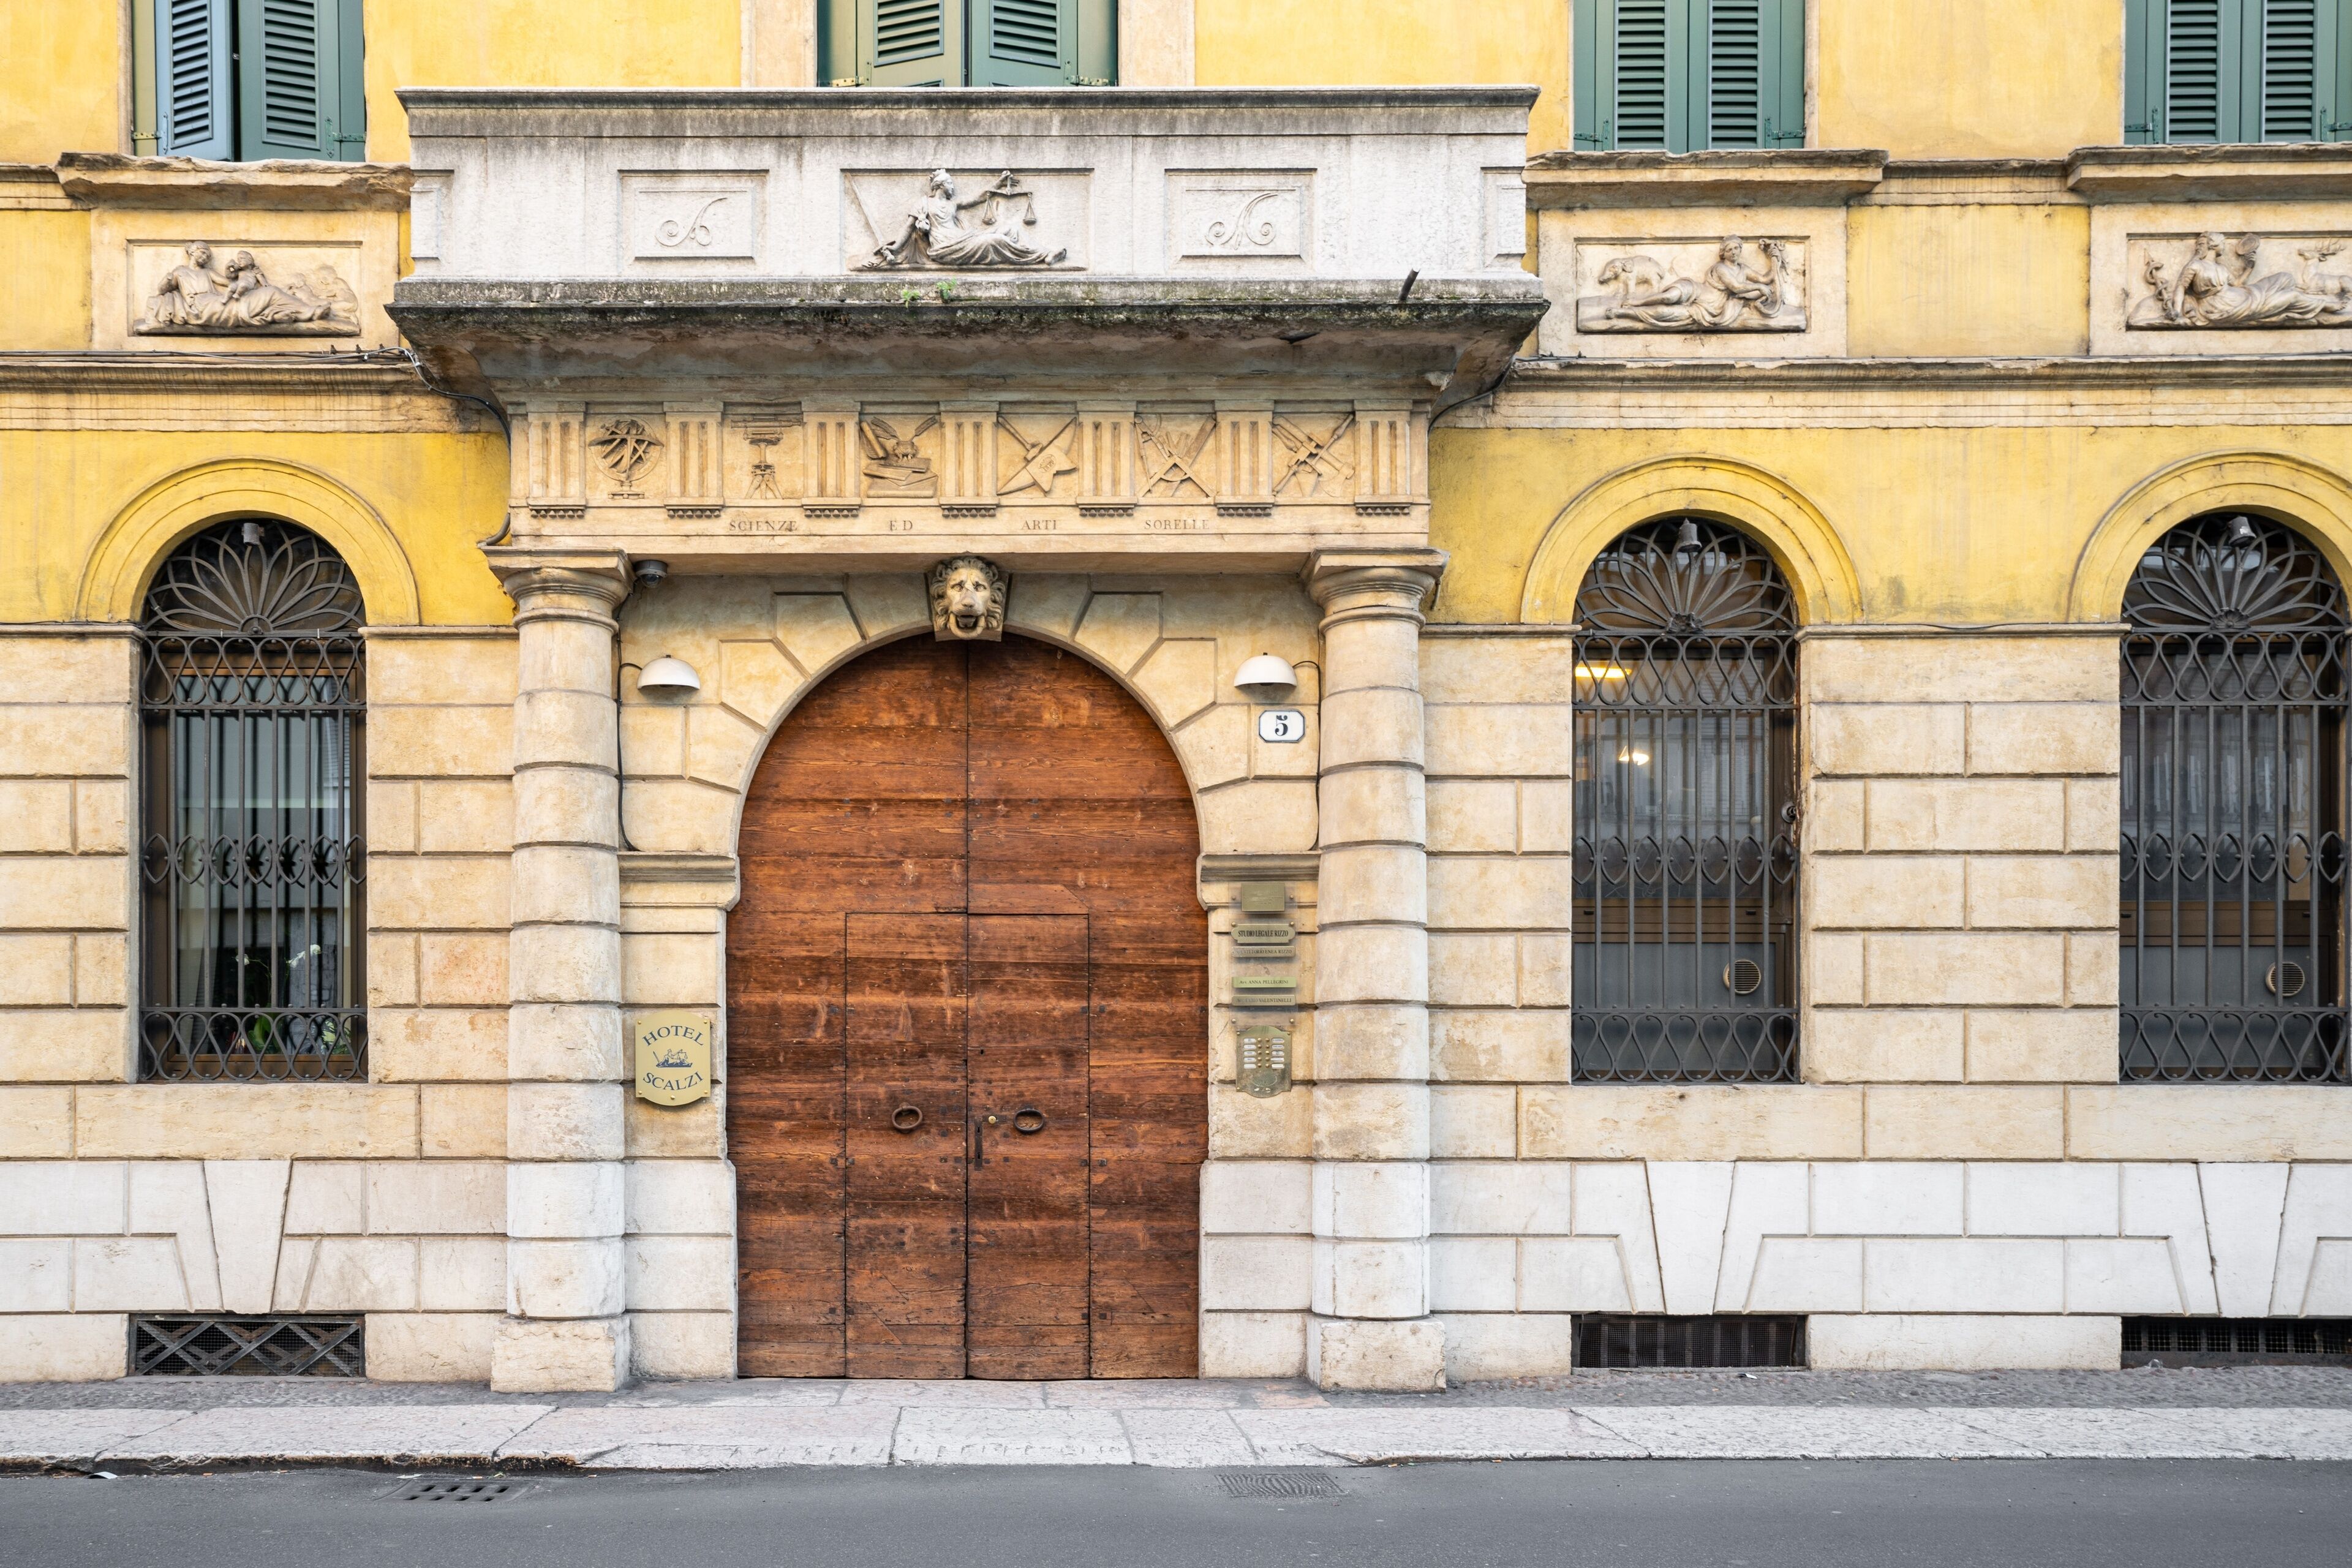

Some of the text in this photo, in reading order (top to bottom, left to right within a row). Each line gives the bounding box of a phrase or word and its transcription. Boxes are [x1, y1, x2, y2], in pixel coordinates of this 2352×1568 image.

[729, 519, 1210, 532] SCIENZE ED ARTI SORELLE
[1275, 715, 1289, 736] 5
[643, 1025, 704, 1046] HOTEL
[643, 1071, 704, 1091] SCALZI
